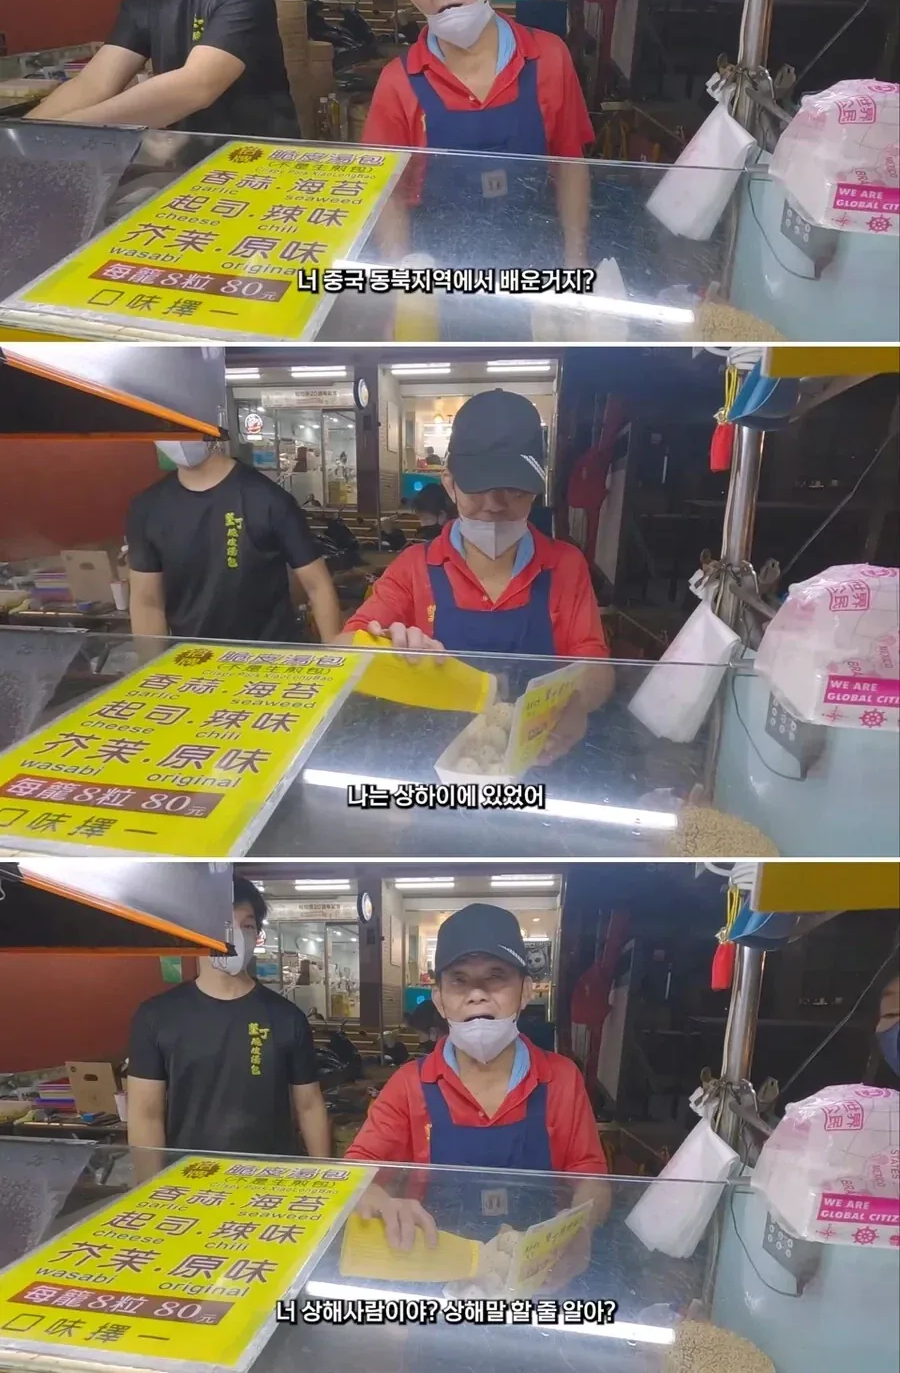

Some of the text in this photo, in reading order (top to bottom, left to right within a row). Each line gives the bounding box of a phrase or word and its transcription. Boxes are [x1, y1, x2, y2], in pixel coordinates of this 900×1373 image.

[189, 185, 363, 204] garlic seaweed
[839, 188, 883, 200] WE ARE
[836, 199, 878, 210] GLOBAL
[155, 212, 297, 233] cheese chili
[109, 246, 304, 276] wasabi origina
[830, 680, 878, 692] WE ARE
[125, 690, 316, 708] garlic seaweed
[827, 692, 873, 704] GLOBAL
[80, 720, 240, 740] cheese chili
[20, 759, 242, 788] wasabi original
[135, 1201, 322, 1220] garlic seaweed
[824, 1198, 871, 1210] WE ARE
[820, 1210, 866, 1221] GLOBAL
[92, 1230, 248, 1251] cheese chili
[35, 1267, 250, 1297] wasabi original
